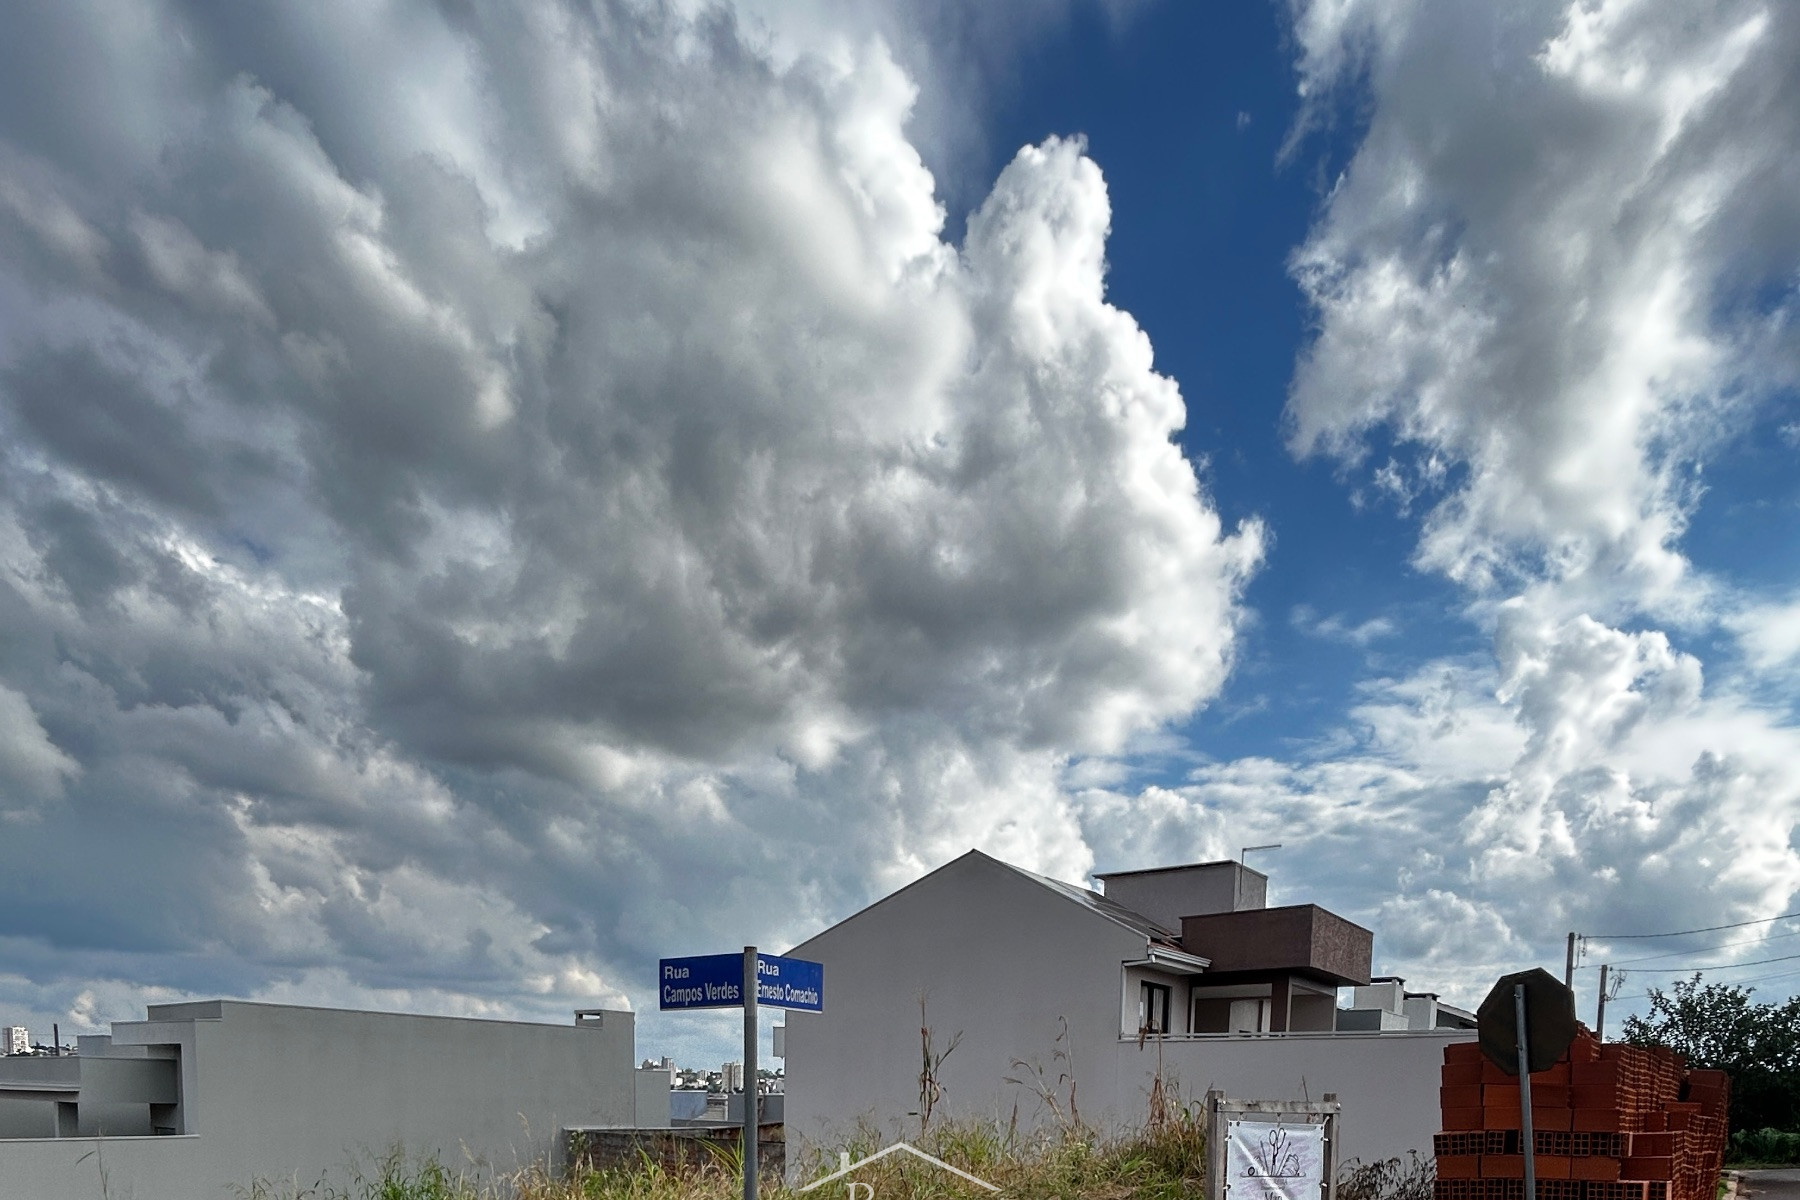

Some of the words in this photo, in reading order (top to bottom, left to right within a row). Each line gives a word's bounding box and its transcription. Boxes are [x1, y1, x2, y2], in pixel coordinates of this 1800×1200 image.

[664, 965, 690, 980] Rua
[757, 959, 780, 976] Rua
[663, 984, 703, 1006] Campos
[704, 981, 740, 1001] Verdes
[757, 979, 784, 1001] Ernesto
